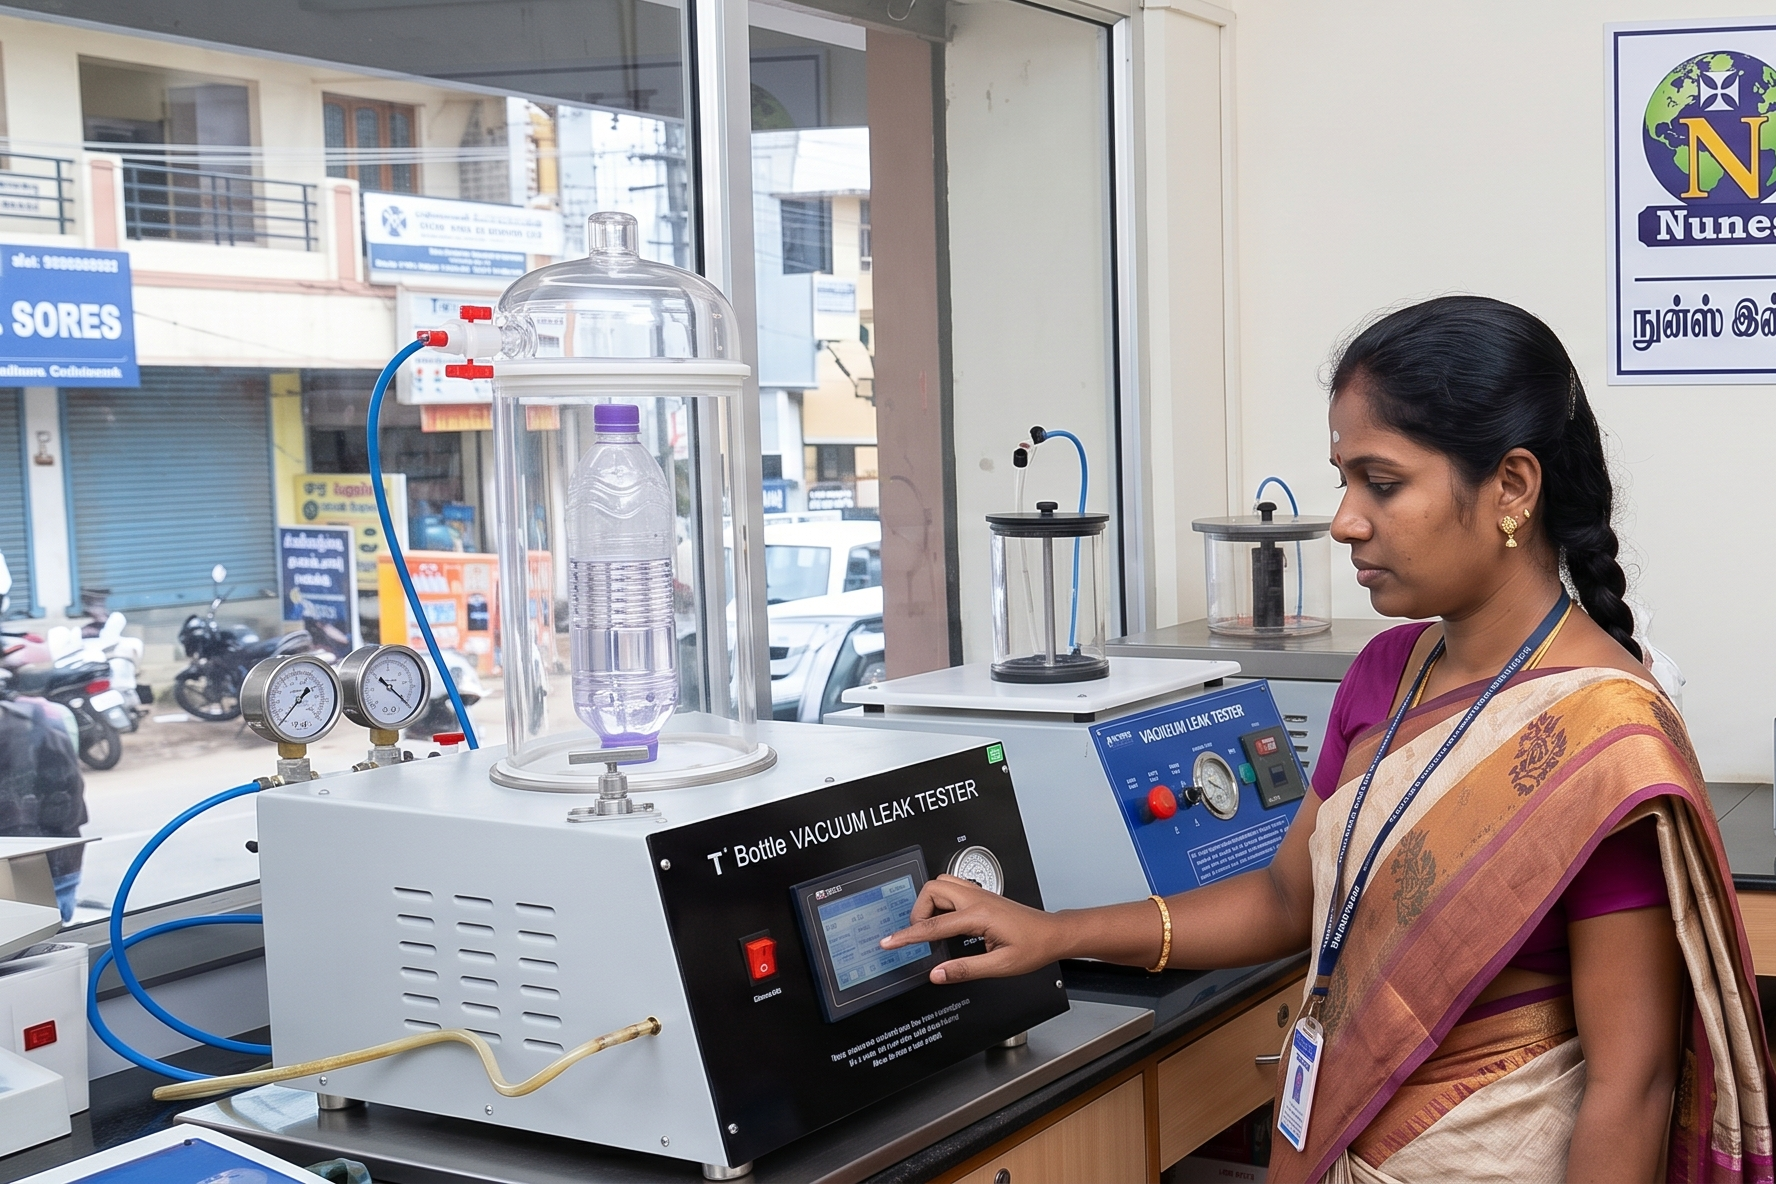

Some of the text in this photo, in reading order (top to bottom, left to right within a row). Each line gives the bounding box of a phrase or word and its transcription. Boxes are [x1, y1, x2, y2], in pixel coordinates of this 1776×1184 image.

[1679, 116, 1768, 199] N
[11, 300, 122, 340] SORES
[1633, 293, 1723, 352] நுன்ஸ்
[1186, 713, 1212, 731] LEAK
[1210, 704, 1245, 724] TESTER
[733, 836, 788, 868] Bottle
[789, 810, 868, 851] VACUUM
[869, 797, 915, 827] LEAK
[914, 779, 979, 813] TESTER
